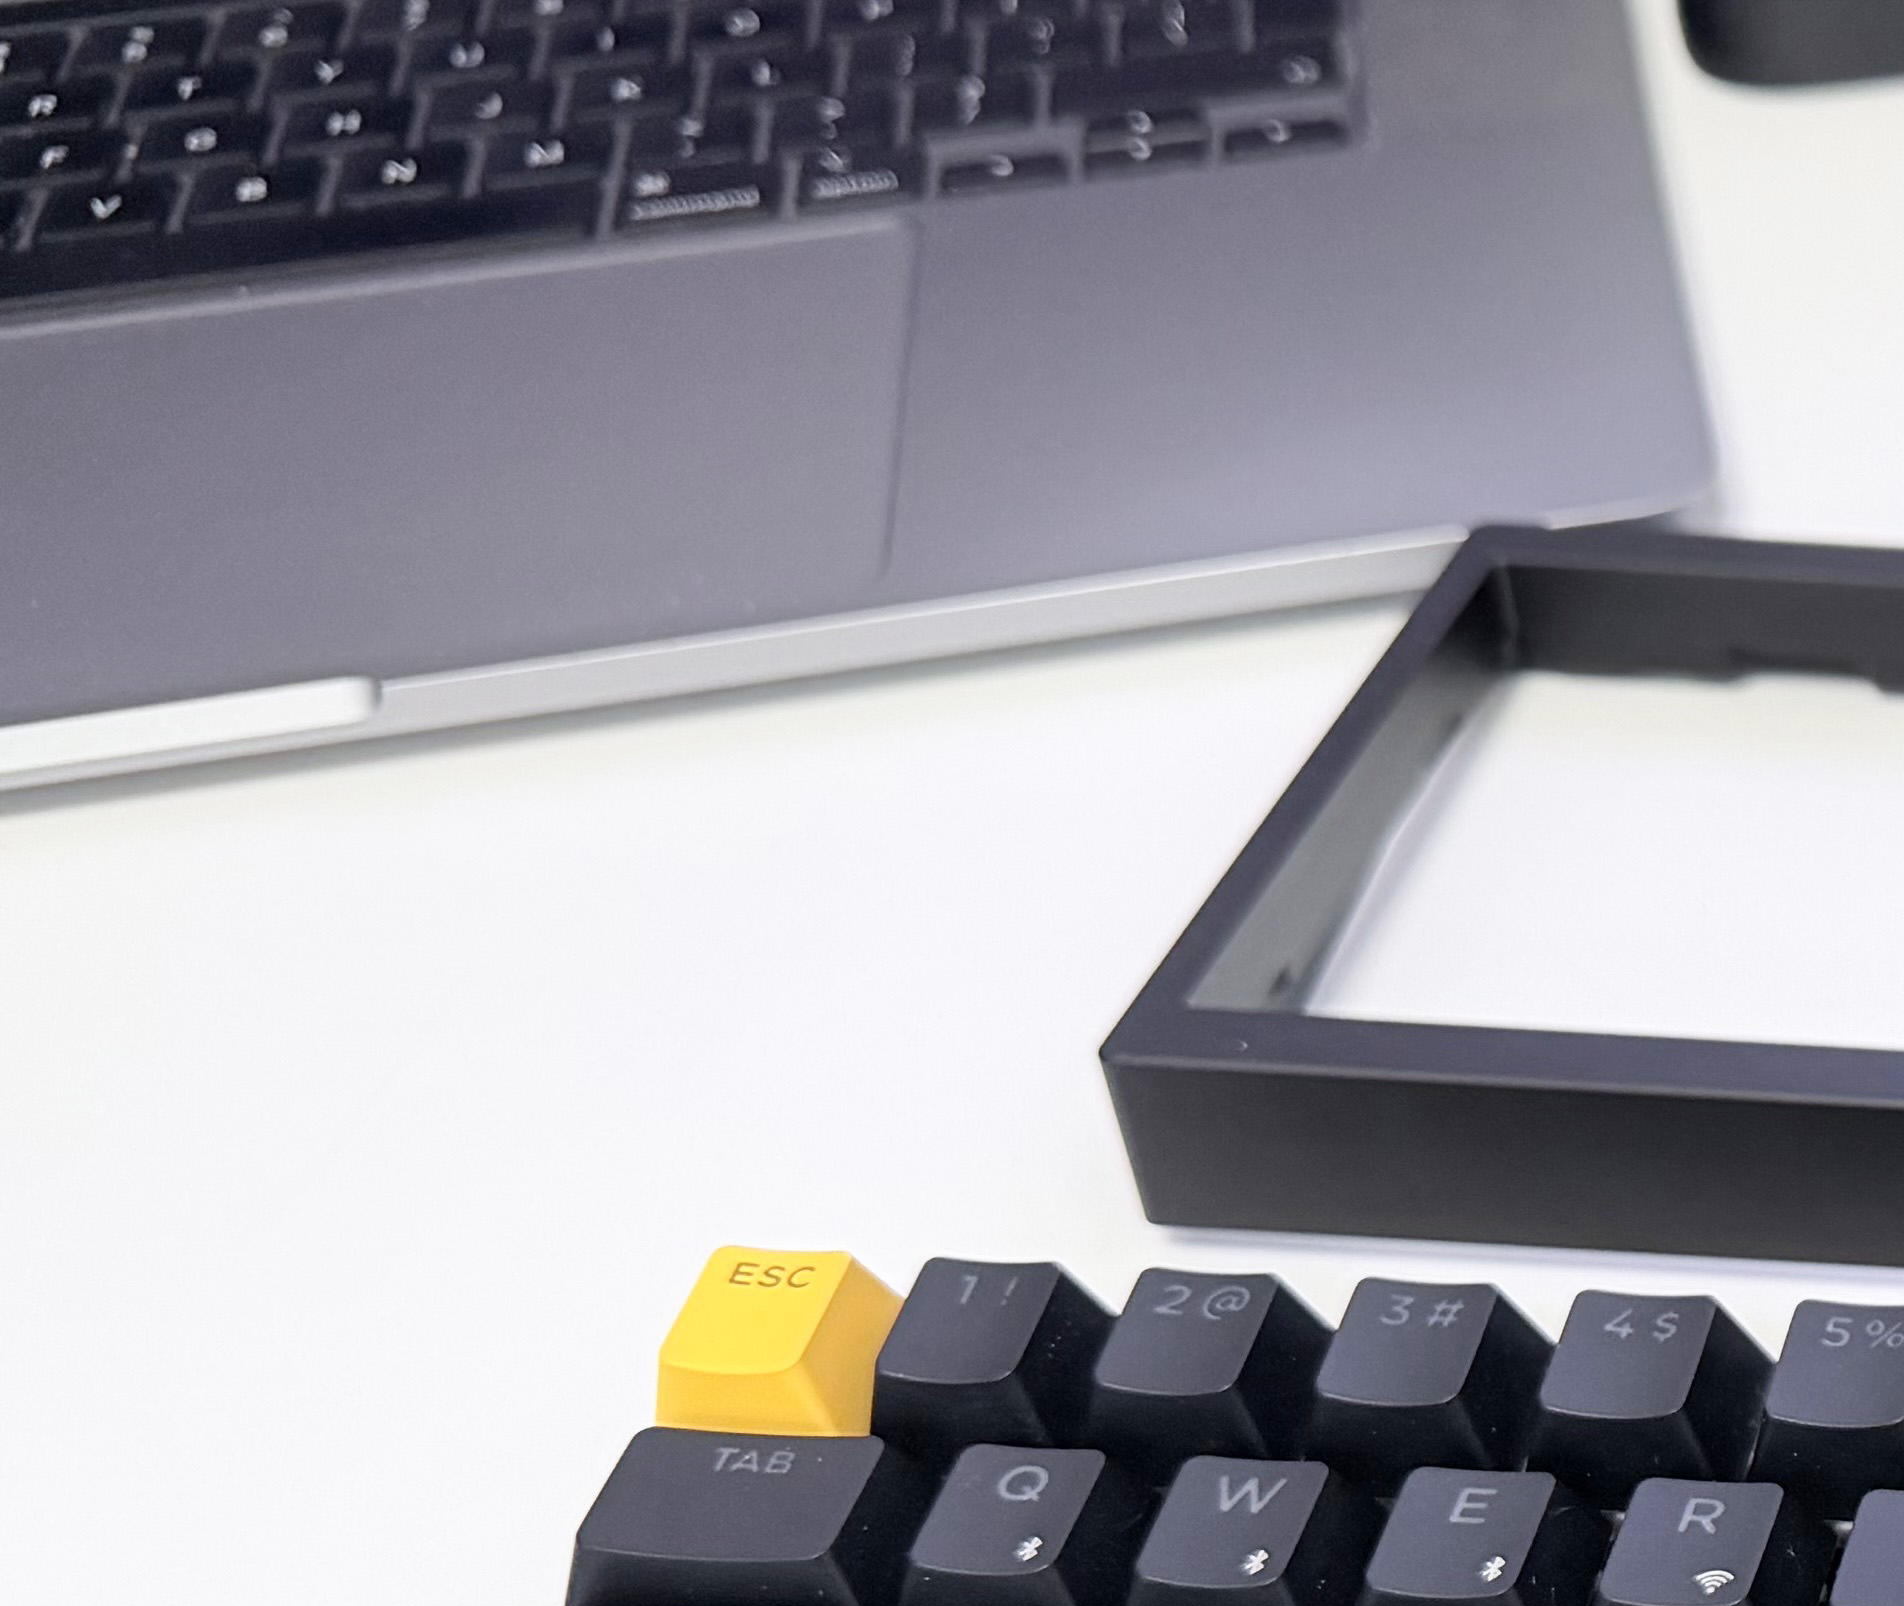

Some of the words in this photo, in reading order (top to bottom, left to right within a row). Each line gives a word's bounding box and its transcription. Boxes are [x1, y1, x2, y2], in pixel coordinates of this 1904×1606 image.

[727, 1261, 816, 1289] ESC
[713, 1446, 796, 1475] TAB
[996, 1465, 1049, 1502] Q
[1218, 1475, 1288, 1514] W
[1448, 1486, 1498, 1525] E
[1677, 1497, 1726, 1534] R
